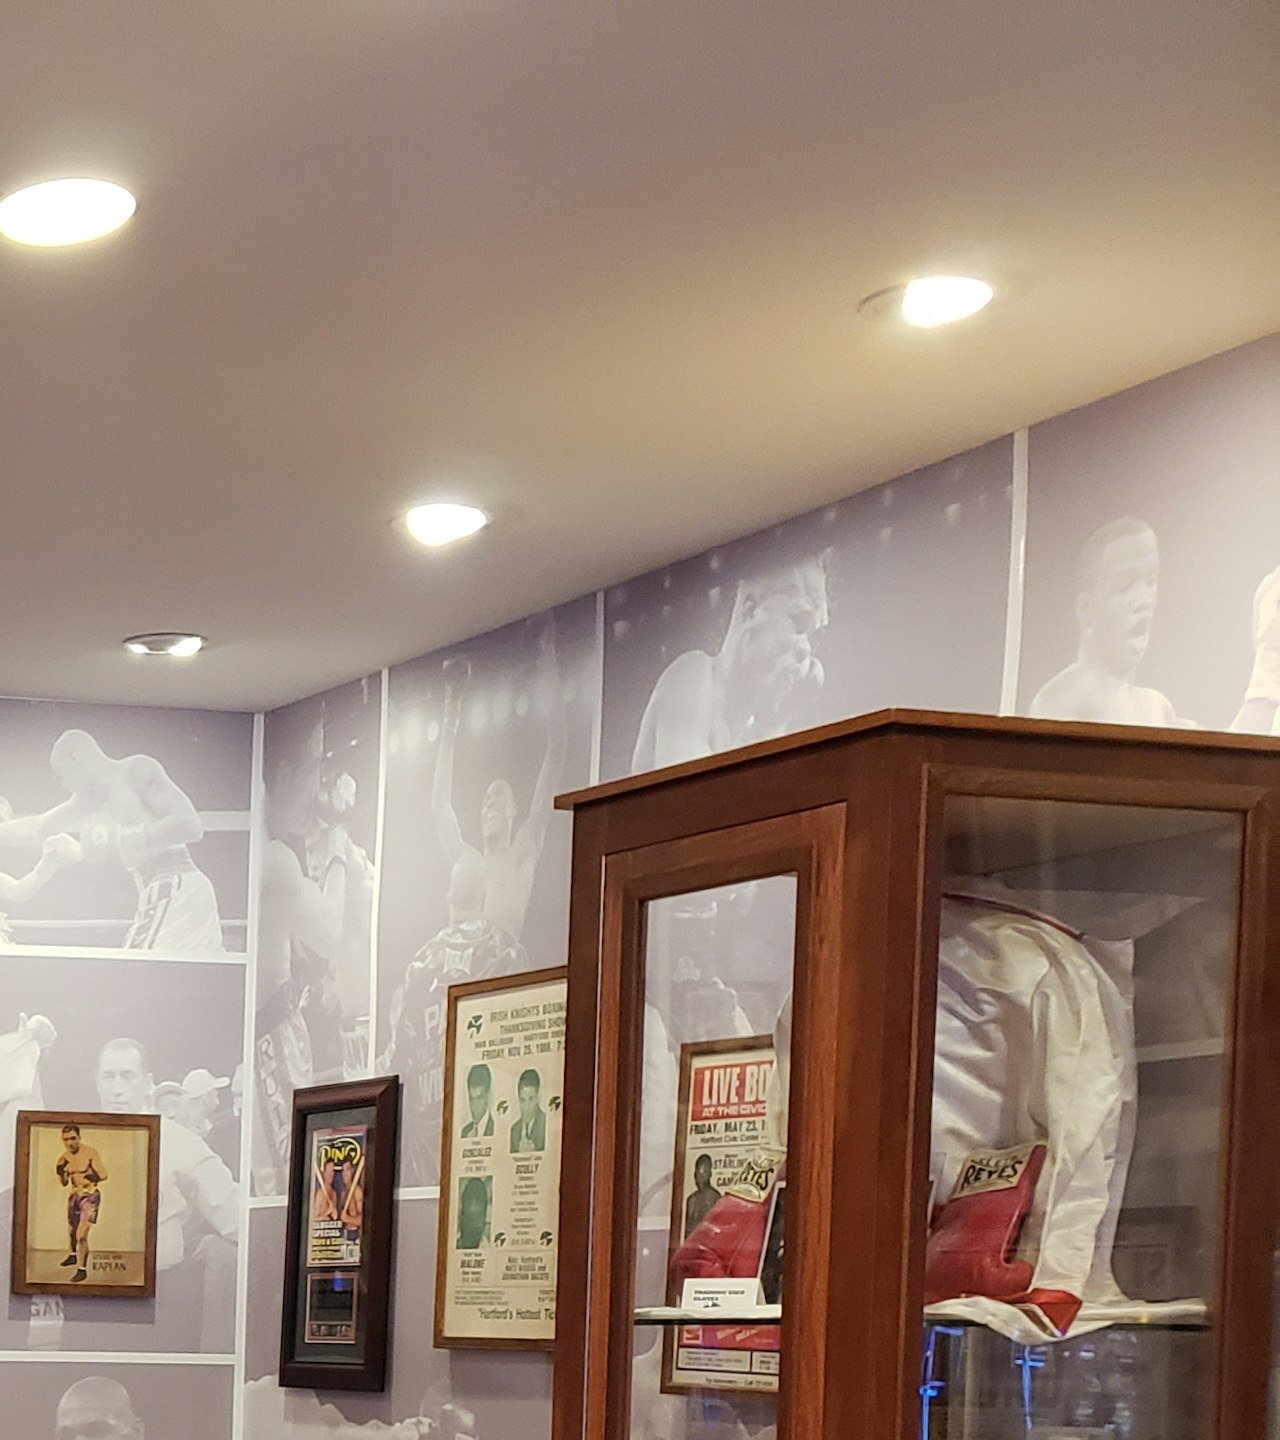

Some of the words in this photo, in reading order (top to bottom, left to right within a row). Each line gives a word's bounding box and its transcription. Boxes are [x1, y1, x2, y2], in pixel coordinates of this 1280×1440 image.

[510, 1005, 540, 1020] KNIGHTS
[543, 1001, 564, 1016] BOXIN
[500, 1020, 546, 1035] THANKSGIVING
[702, 1066, 741, 1106] LIVE
[744, 1063, 771, 1103] BO
[702, 1106, 715, 1117] AT
[718, 1104, 738, 1116] THE
[725, 1121, 744, 1133] MAY
[319, 1137, 362, 1172] RING
[712, 1158, 748, 1170] STARLIN
[961, 1160, 1024, 1192] REYES
[92, 1261, 127, 1272] KAPLAN
[460, 1258, 486, 1269] MALONE
[544, 1308, 555, 1320] Tic
